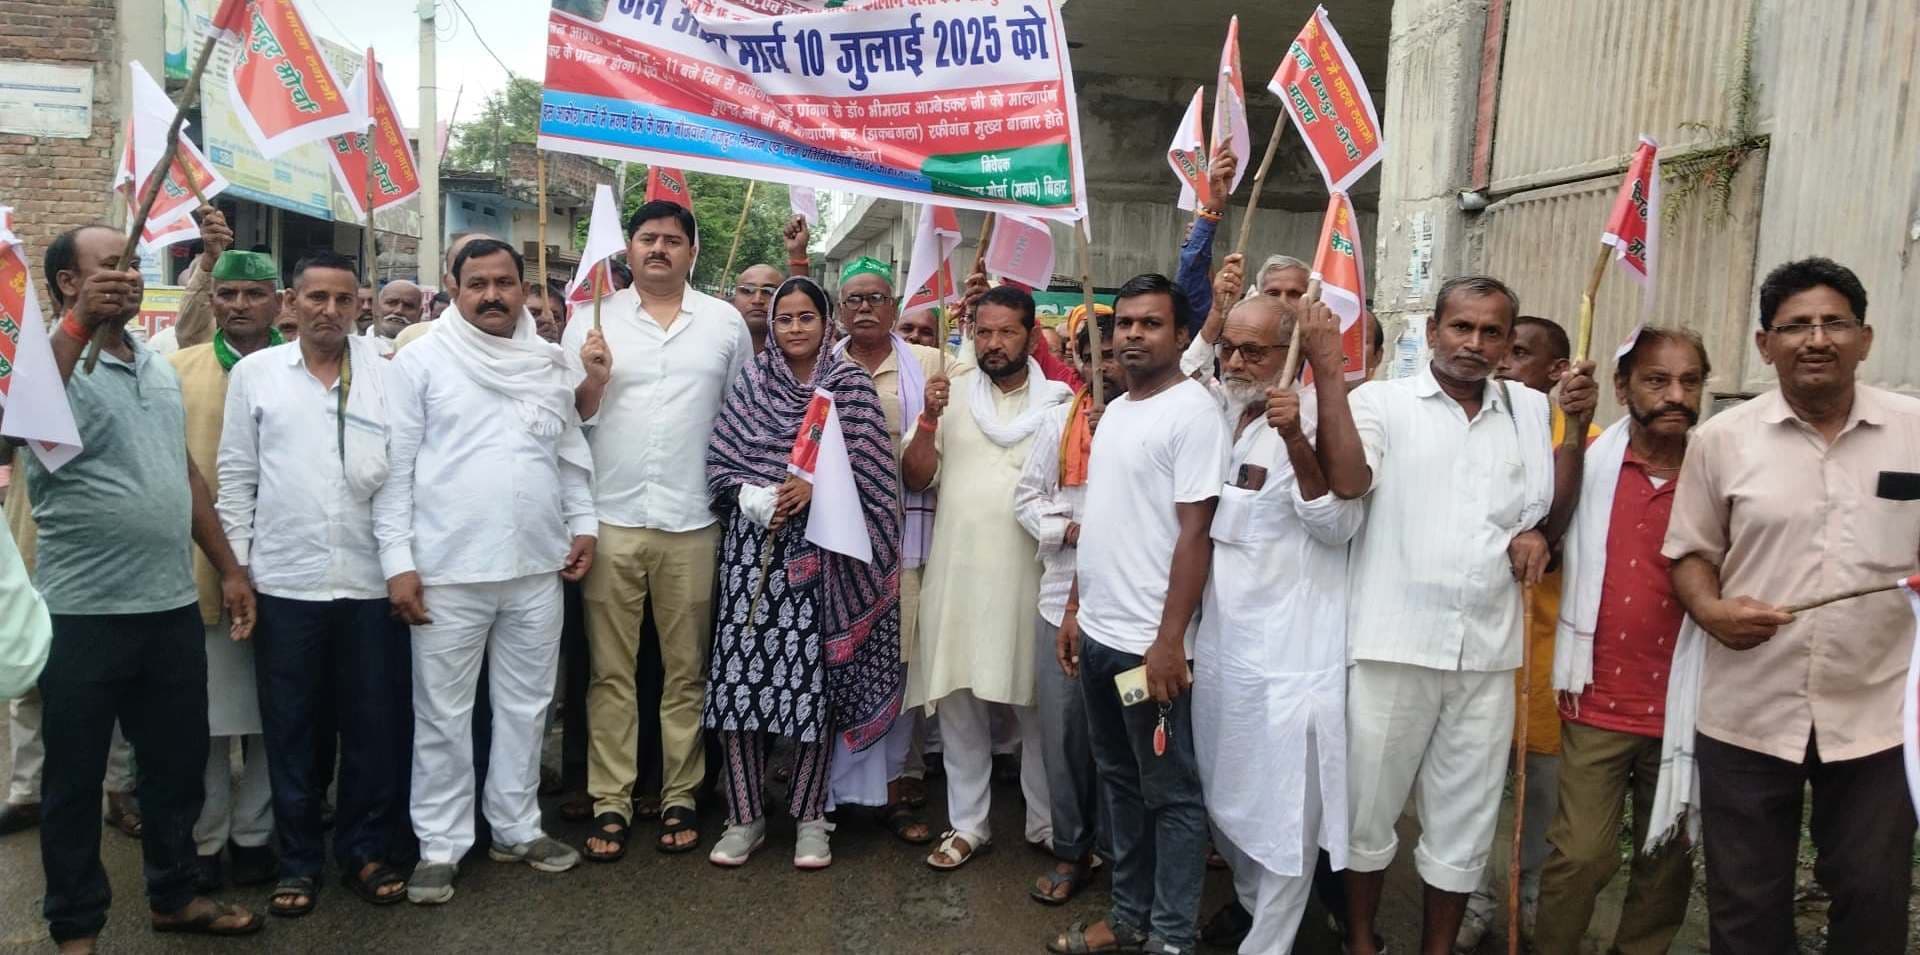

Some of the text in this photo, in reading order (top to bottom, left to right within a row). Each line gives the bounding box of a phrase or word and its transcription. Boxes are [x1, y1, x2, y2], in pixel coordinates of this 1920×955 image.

[729, 20, 791, 74] मार्च
[794, 29, 825, 77] 10
[830, 13, 924, 91] जुलाई
[933, 15, 1004, 68] 2025
[1006, 5, 1049, 61] को
[273, 59, 321, 113] मोर्चा
[665, 56, 679, 75] 11
[868, 98, 911, 118] भीमराव
[970, 91, 986, 110] जी
[988, 90, 1005, 108] को
[1287, 82, 1320, 125] मगध
[974, 119, 1004, 141] मुख्य
[1334, 119, 1362, 162] मोर्चा
[981, 154, 1011, 174] निवेदक
[1010, 178, 1041, 202] (मगध)
[1043, 175, 1068, 197] बिहार
